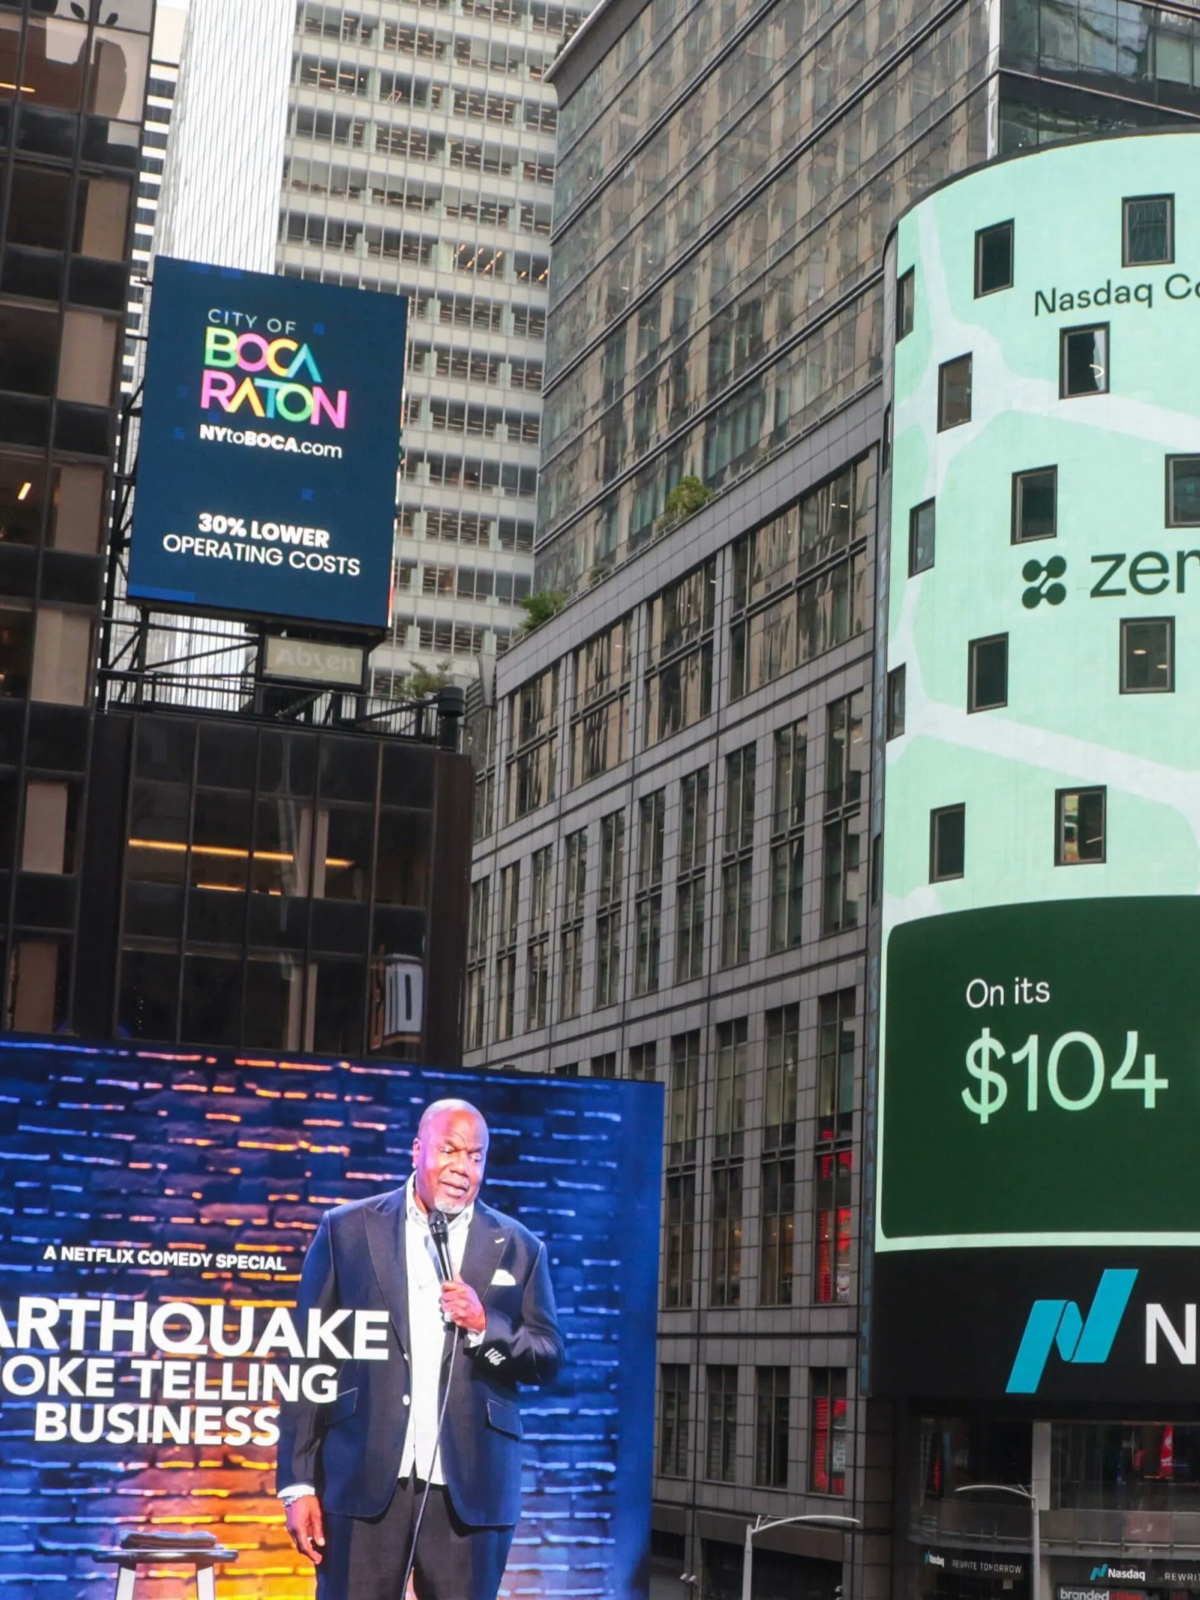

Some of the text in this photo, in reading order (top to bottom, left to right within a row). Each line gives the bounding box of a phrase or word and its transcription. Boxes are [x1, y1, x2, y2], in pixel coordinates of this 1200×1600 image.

[1034, 279, 1154, 316] Nasdaq
[208, 309, 297, 335] CITY OF
[204, 326, 322, 383] BOCA
[200, 369, 348, 430] RATON
[200, 423, 343, 459] NYtoBOCA.com
[198, 512, 330, 548] 30% LOWER
[162, 533, 361, 576] OPERATING COSTS
[965, 976, 1051, 1009] On its
[961, 1027, 1168, 1124] $104
[43, 1246, 287, 1271] A NETFLIX COMEDY SPECIAL
[0, 1297, 389, 1360] RTHQUAKE
[131, 1360, 338, 1404] TELLING
[34, 1402, 281, 1446] BUSINESS
[1108, 1567, 1146, 1582] Nasdaq
